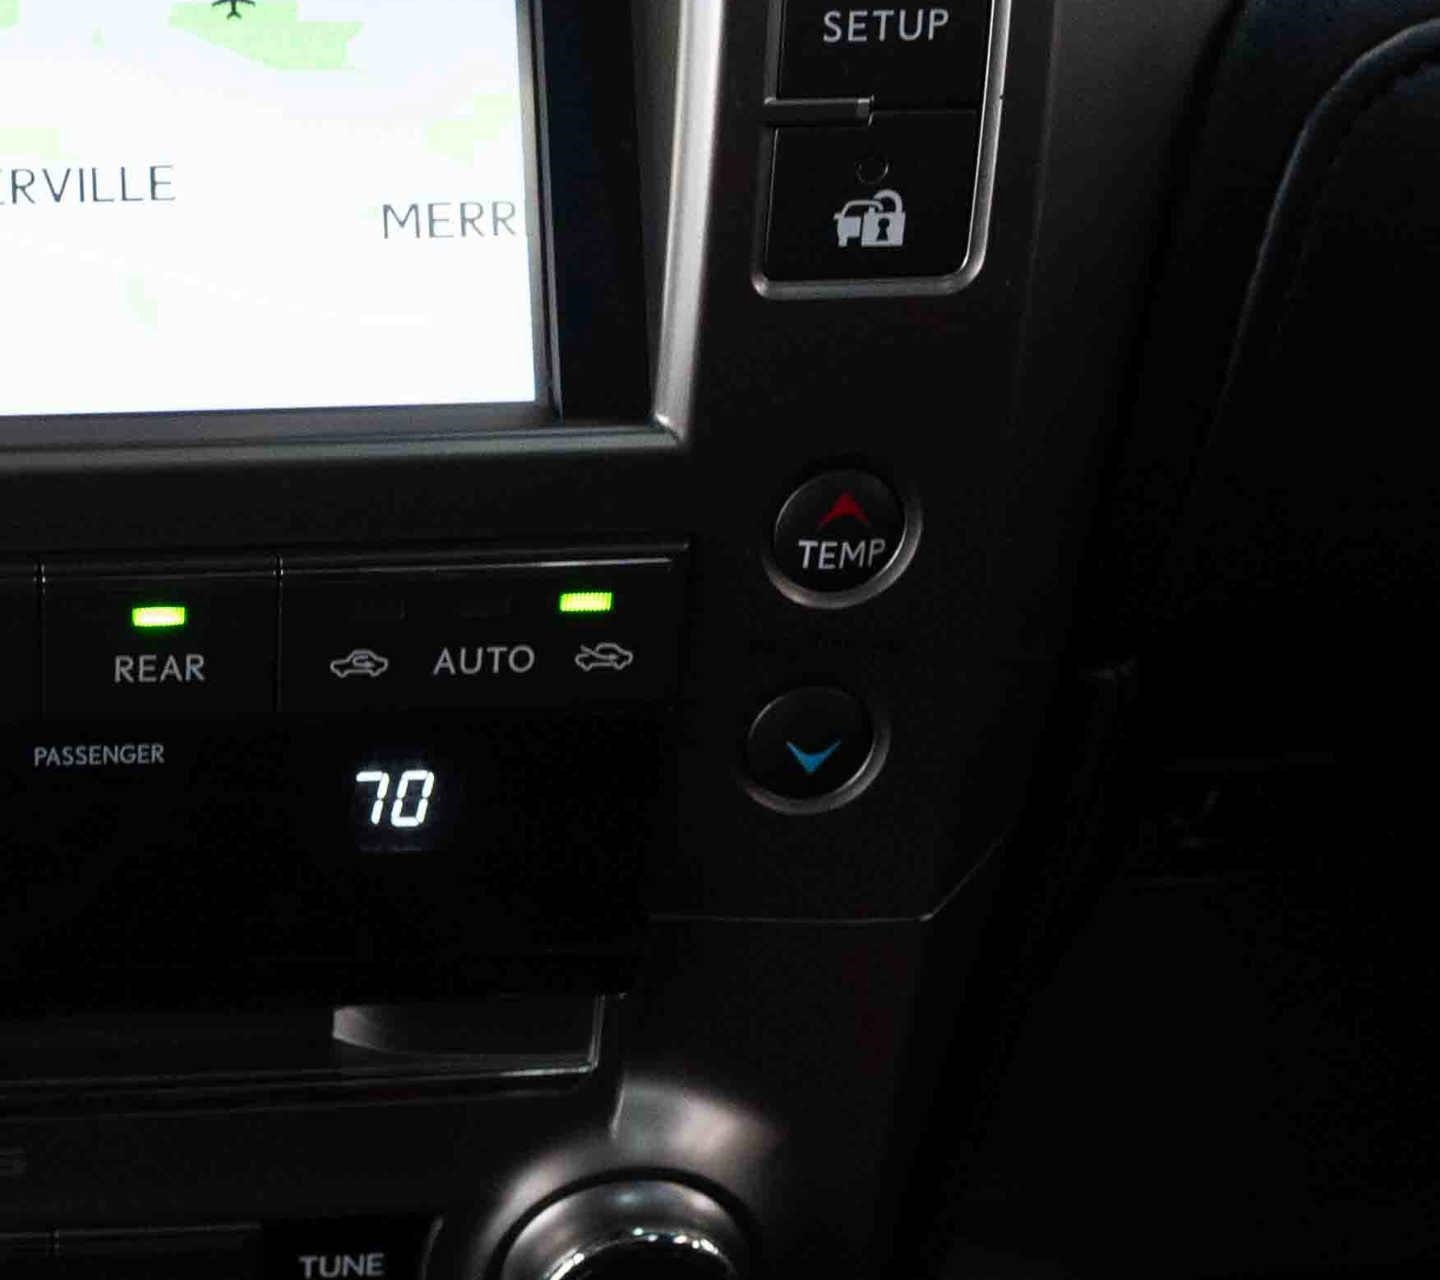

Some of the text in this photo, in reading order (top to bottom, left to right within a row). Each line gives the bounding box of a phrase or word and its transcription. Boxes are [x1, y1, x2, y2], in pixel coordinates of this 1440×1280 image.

[823, 9, 949, 42] SETUP
[382, 201, 516, 239] MERR
[798, 538, 886, 572] TEMP
[114, 653, 205, 684] REAR
[433, 645, 534, 676] AUTO
[34, 744, 165, 766] PASSENGER
[355, 770, 435, 827] 70
[300, 1253, 384, 1280] TUNE
